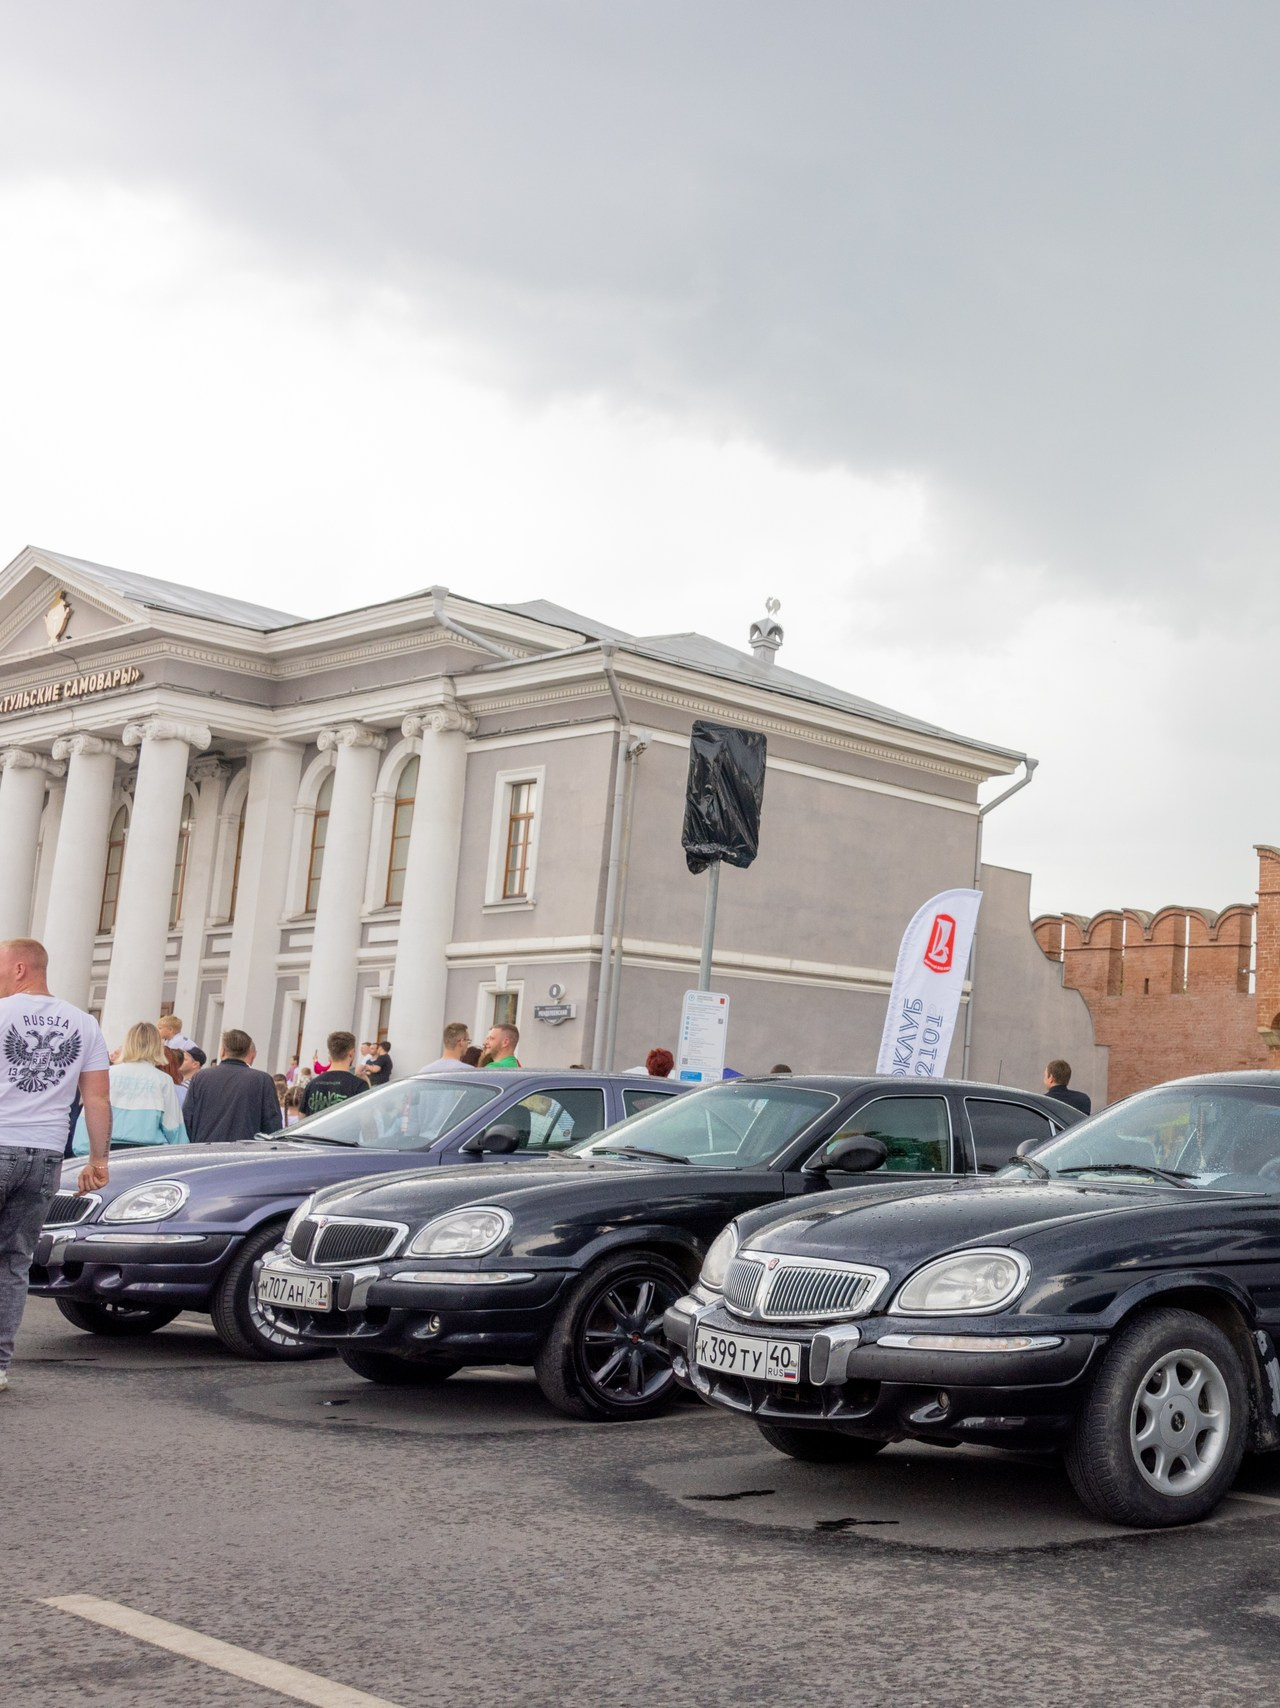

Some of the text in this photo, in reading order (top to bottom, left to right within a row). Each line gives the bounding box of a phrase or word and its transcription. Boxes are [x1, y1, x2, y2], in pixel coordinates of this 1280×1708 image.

[63, 667, 140, 697] САМОВАРЫ»
[23, 1015, 69, 1029] RUSSIA
[915, 1014, 943, 1077] 2101
[8, 1067, 18, 1076] 13
[309, 1281, 323, 1299] 71
[770, 1345, 791, 1368] 40
[768, 1367, 784, 1377] RUS
